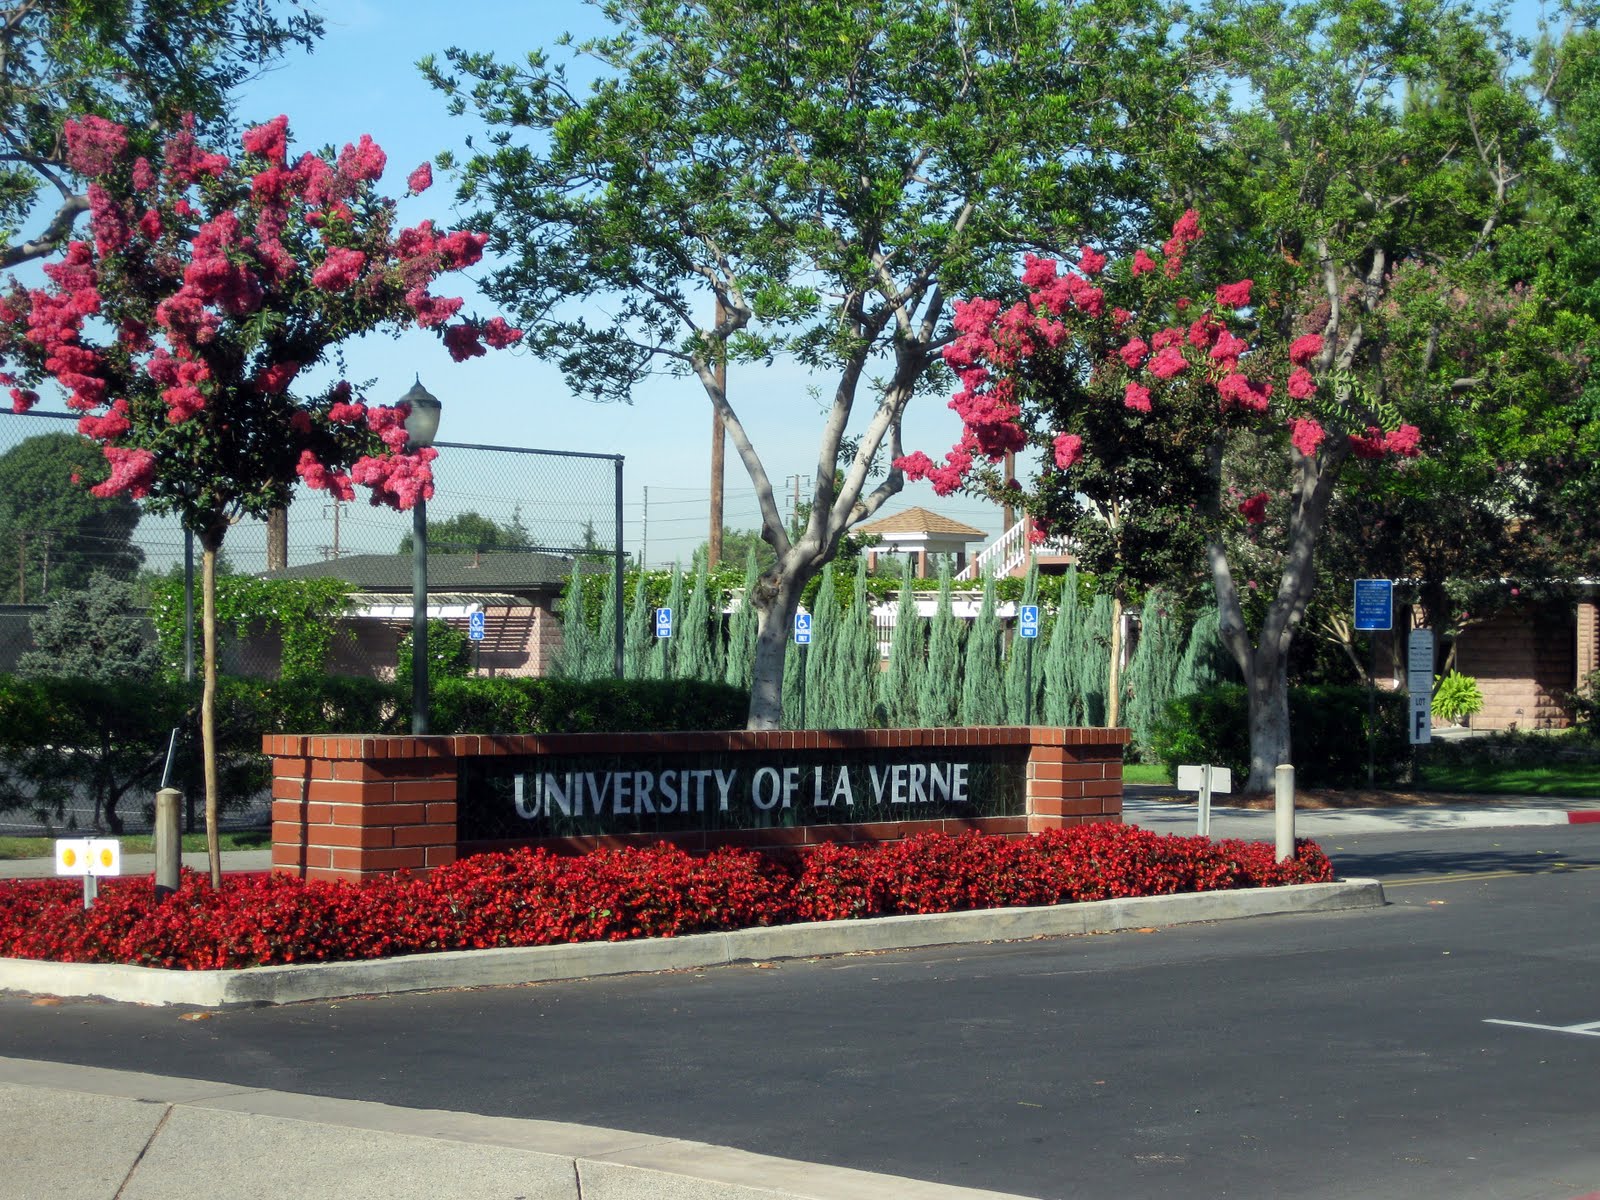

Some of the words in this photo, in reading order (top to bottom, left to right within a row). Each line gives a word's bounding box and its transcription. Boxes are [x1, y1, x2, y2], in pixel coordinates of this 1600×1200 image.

[1415, 698, 1426, 706] LOT
[1415, 711, 1426, 739] F
[514, 769, 737, 819] UNIVERSITY
[752, 767, 799, 810] OF
[814, 765, 854, 807] LA
[868, 762, 969, 804] VERNE
